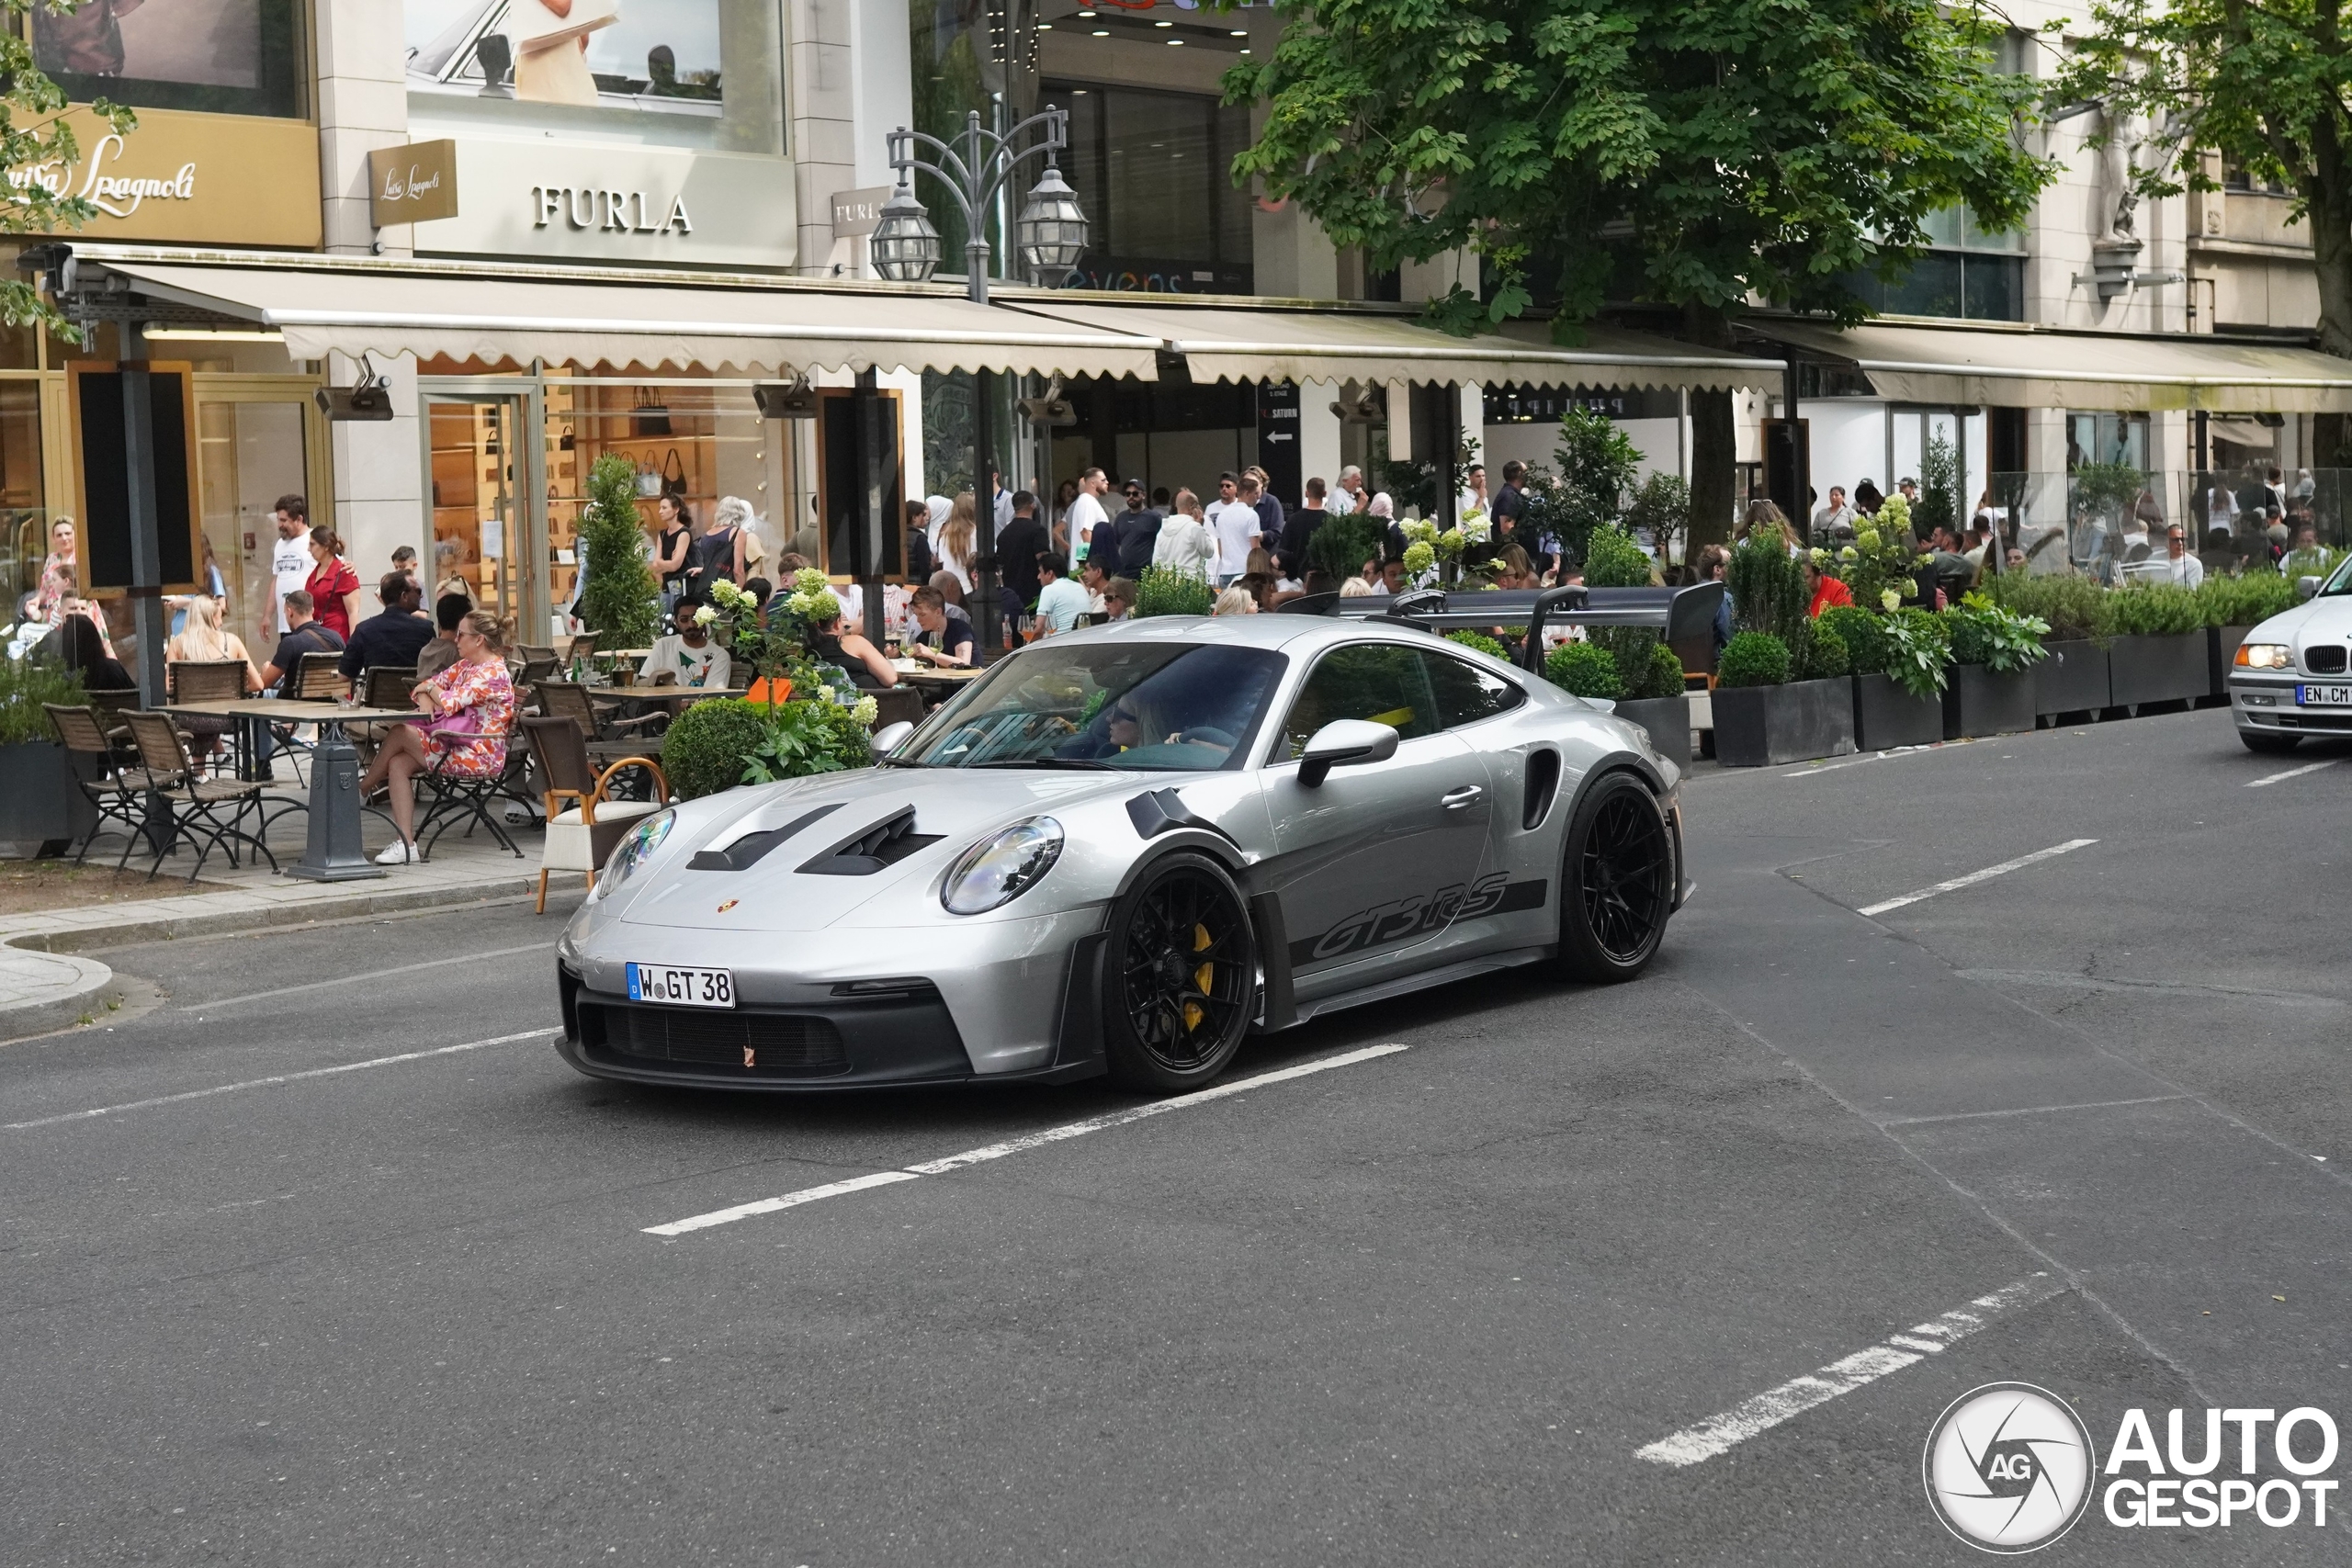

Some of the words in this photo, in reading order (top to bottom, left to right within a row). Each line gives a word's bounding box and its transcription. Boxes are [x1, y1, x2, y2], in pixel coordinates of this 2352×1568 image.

[380, 167, 405, 200] Luisa
[404, 164, 439, 200] Spagnoli
[532, 186, 694, 231] FURLA
[1272, 408, 1298, 419] SATURN
[2305, 687, 2322, 703] EN
[2331, 688, 2348, 703] CM
[639, 968, 652, 998] W
[666, 970, 695, 1000] GT
[700, 972, 731, 1003] 38
